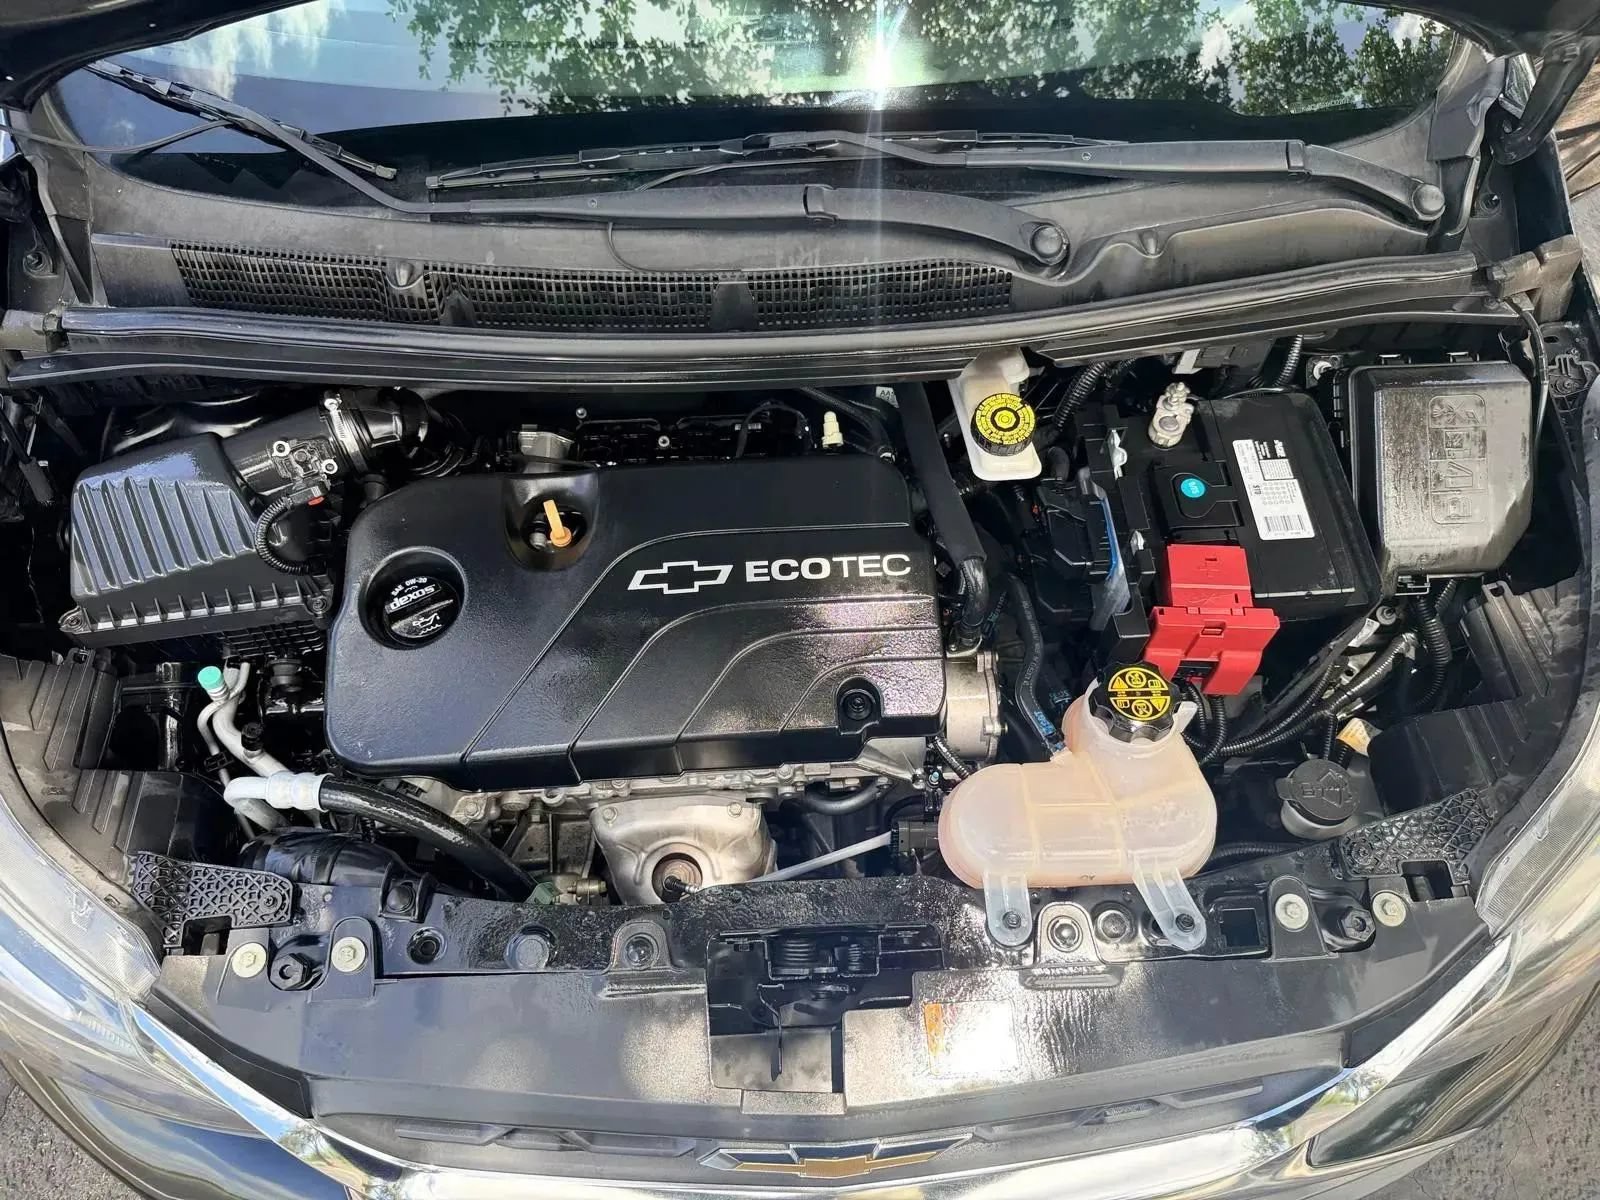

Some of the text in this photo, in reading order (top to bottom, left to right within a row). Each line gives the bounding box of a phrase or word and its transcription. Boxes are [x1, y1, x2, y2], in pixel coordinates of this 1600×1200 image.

[745, 553, 911, 582] ECOTEC
[389, 584, 436, 610] dexos
[391, 577, 428, 596] SAE 0W-20
